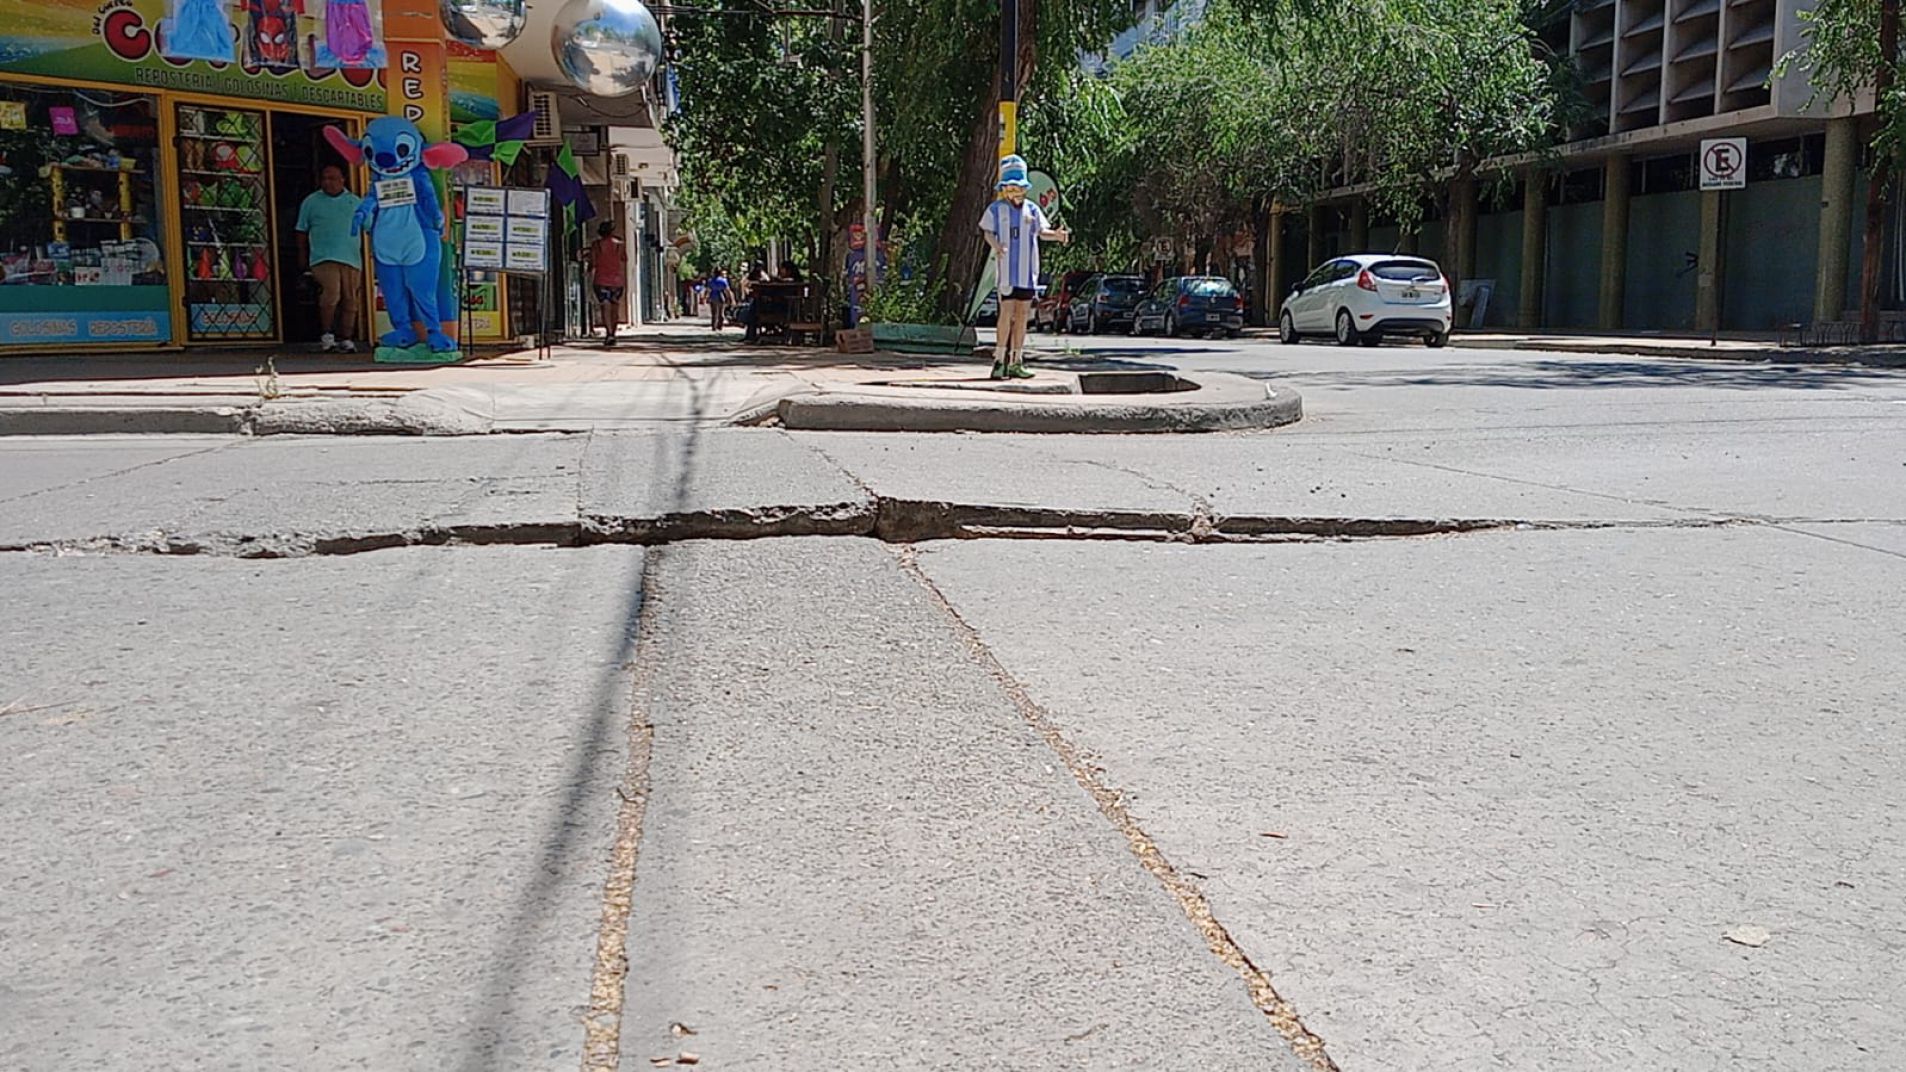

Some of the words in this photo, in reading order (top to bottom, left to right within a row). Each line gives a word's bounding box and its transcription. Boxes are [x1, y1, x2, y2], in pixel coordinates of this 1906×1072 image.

[135, 68, 212, 89] REPOSTERIA
[224, 77, 288, 97] GOLOSINAS
[302, 88, 383, 108] DESCARTABLES
[1715, 148, 1730, 172] E
